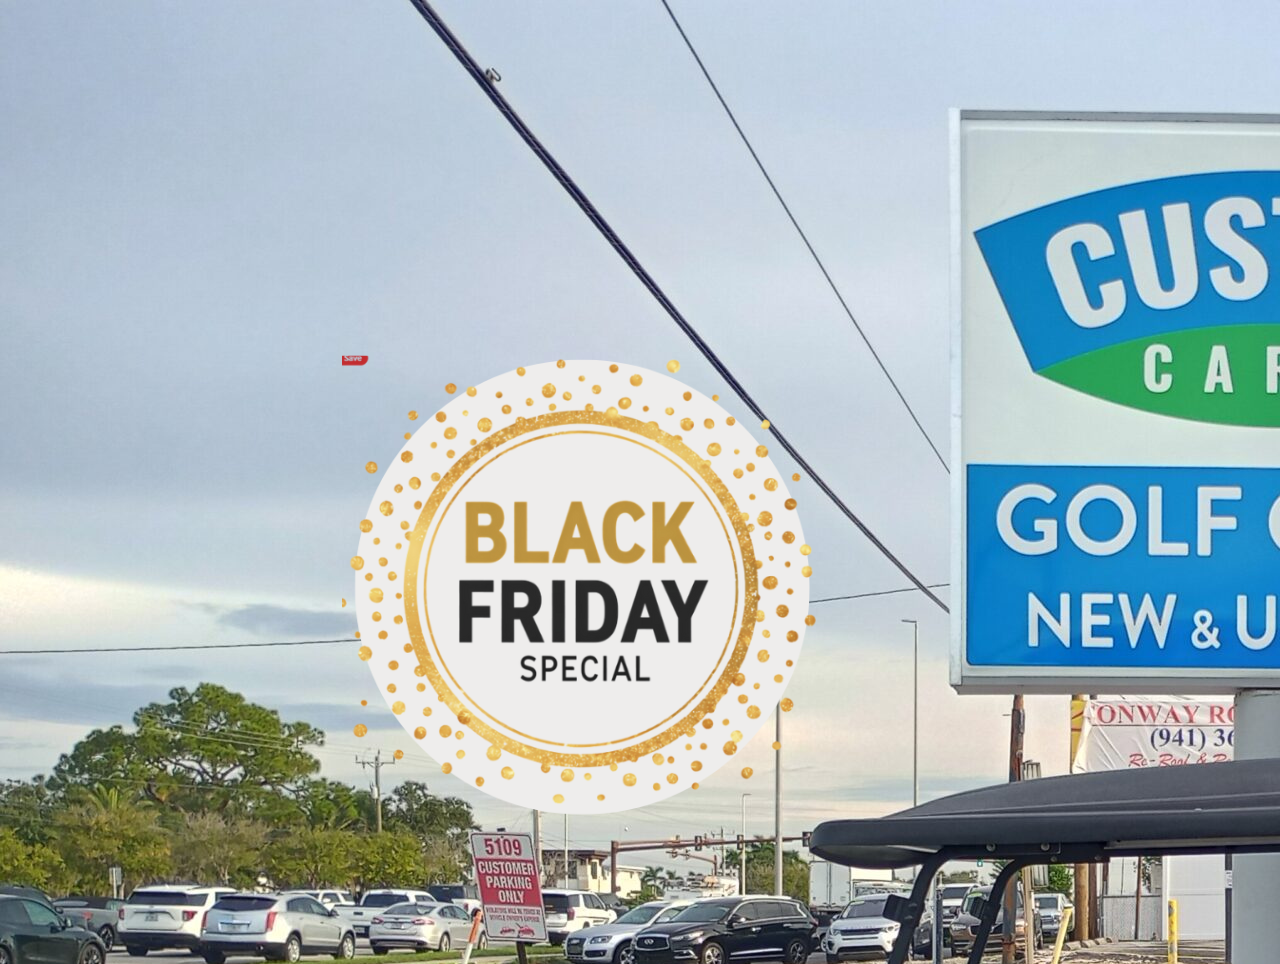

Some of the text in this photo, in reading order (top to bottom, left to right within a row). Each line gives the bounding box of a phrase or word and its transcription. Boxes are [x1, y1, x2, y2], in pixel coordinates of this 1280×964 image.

[996, 483, 1242, 557] GOLF
[1028, 592, 1177, 649] NEW
[1190, 609, 1221, 650] &
[1091, 704, 1199, 724] ONWAY
[1150, 728, 1206, 751] (941)
[484, 838, 522, 856] 5109
[478, 861, 535, 876] CUSTOMER
[486, 876, 532, 890] PARKING
[498, 890, 524, 903] ONLY
